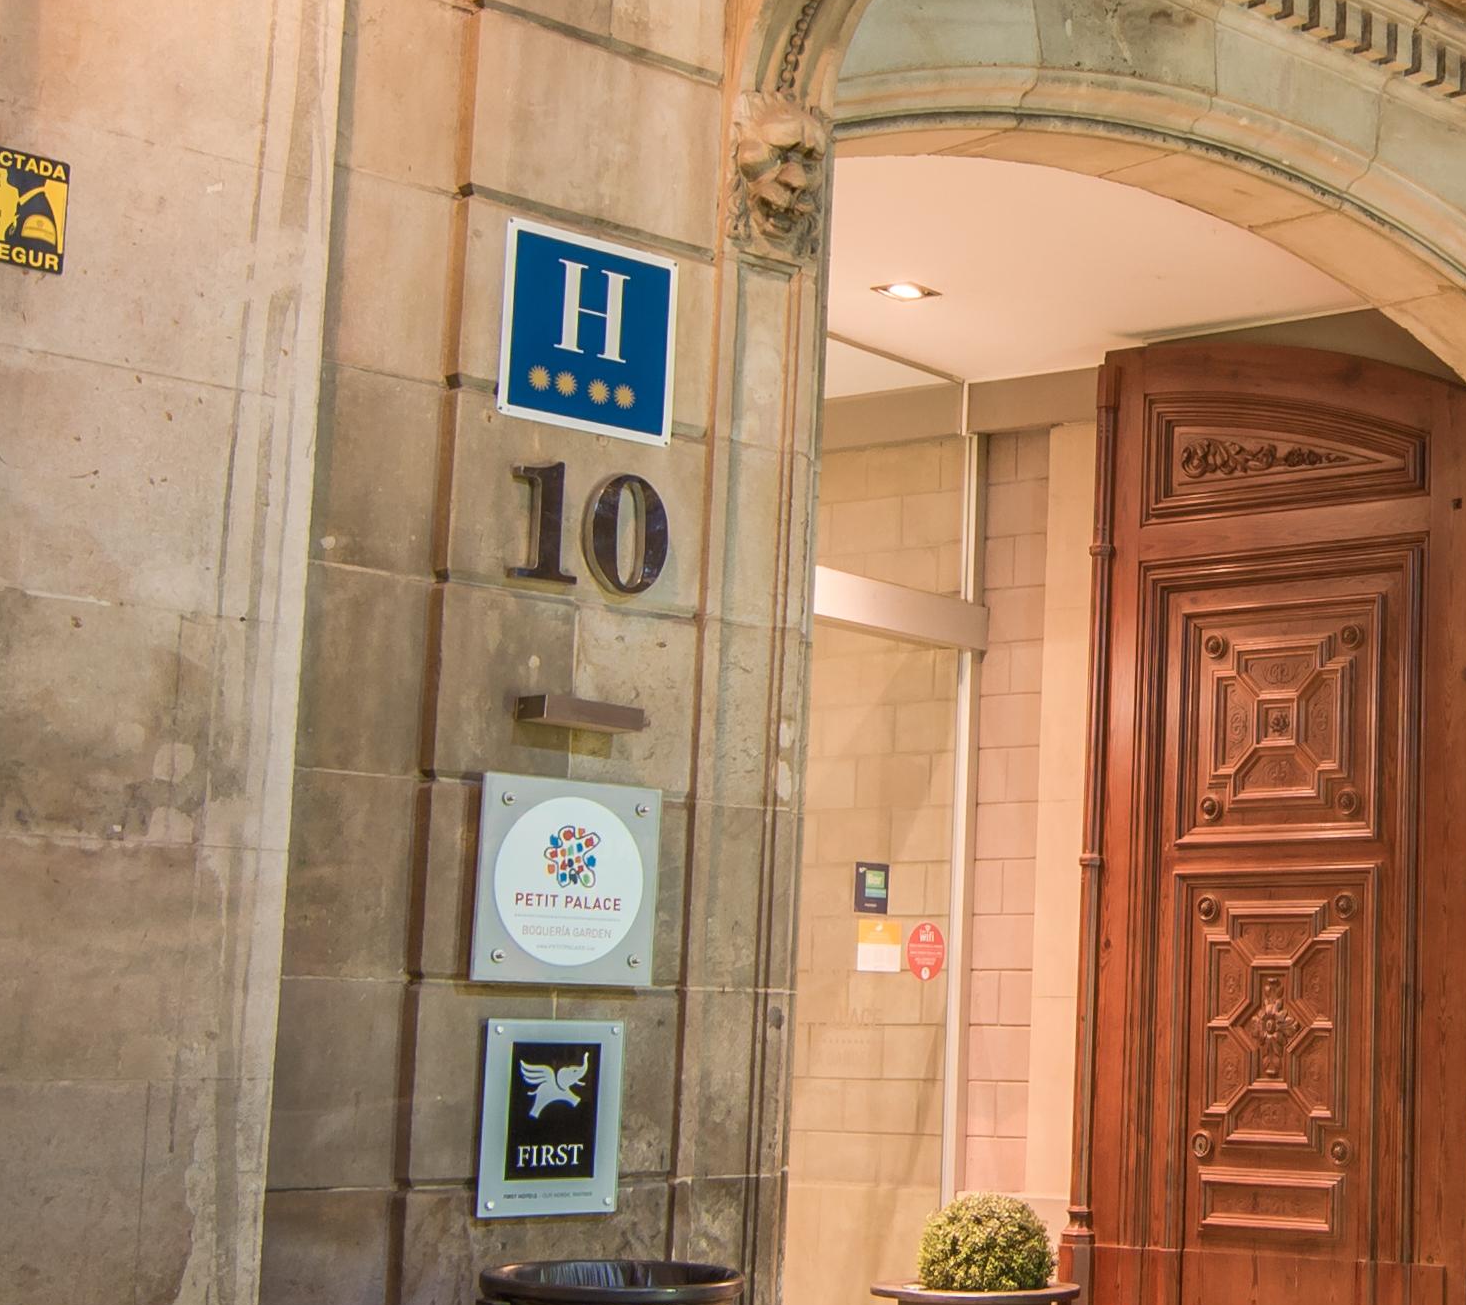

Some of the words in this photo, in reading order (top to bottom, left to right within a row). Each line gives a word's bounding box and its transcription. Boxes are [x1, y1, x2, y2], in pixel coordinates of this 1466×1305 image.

[553, 258, 631, 364] H
[506, 461, 669, 595] 10
[515, 892, 558, 908] PETIT
[565, 895, 622, 911] PALACE
[522, 925, 571, 936] BOQUERÍA
[572, 927, 612, 939] GARDEN
[516, 1143, 584, 1167] FIRST
